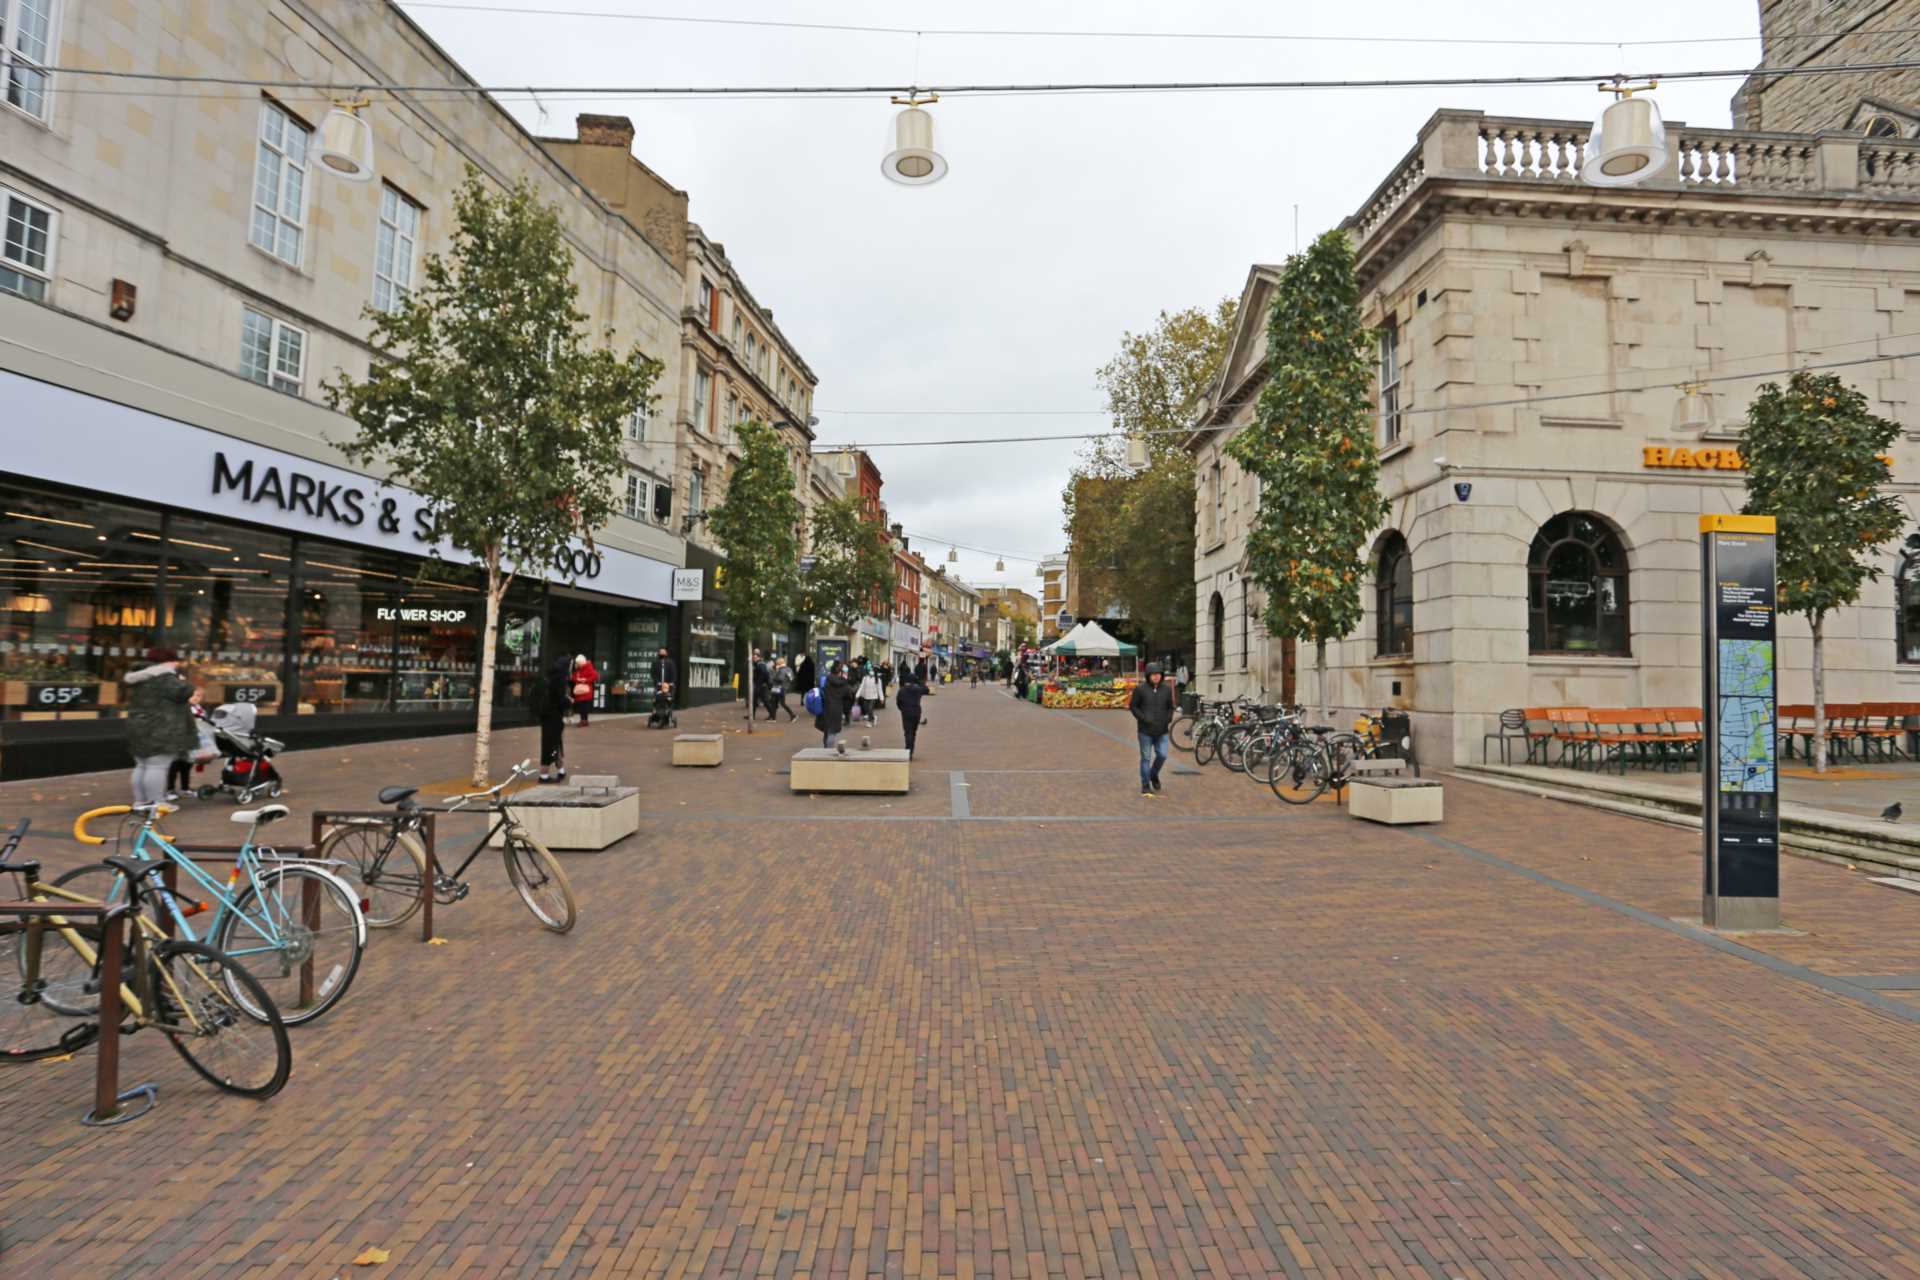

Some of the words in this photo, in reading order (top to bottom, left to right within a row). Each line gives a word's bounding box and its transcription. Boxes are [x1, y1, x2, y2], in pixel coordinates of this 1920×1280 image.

[1643, 447, 1748, 469] HACK
[212, 452, 364, 526] MARKS
[378, 498, 400, 533] &
[554, 544, 601, 578] OOD
[676, 576, 700, 587] M&S
[377, 607, 428, 621] FLOWER
[429, 609, 466, 623] SHOP
